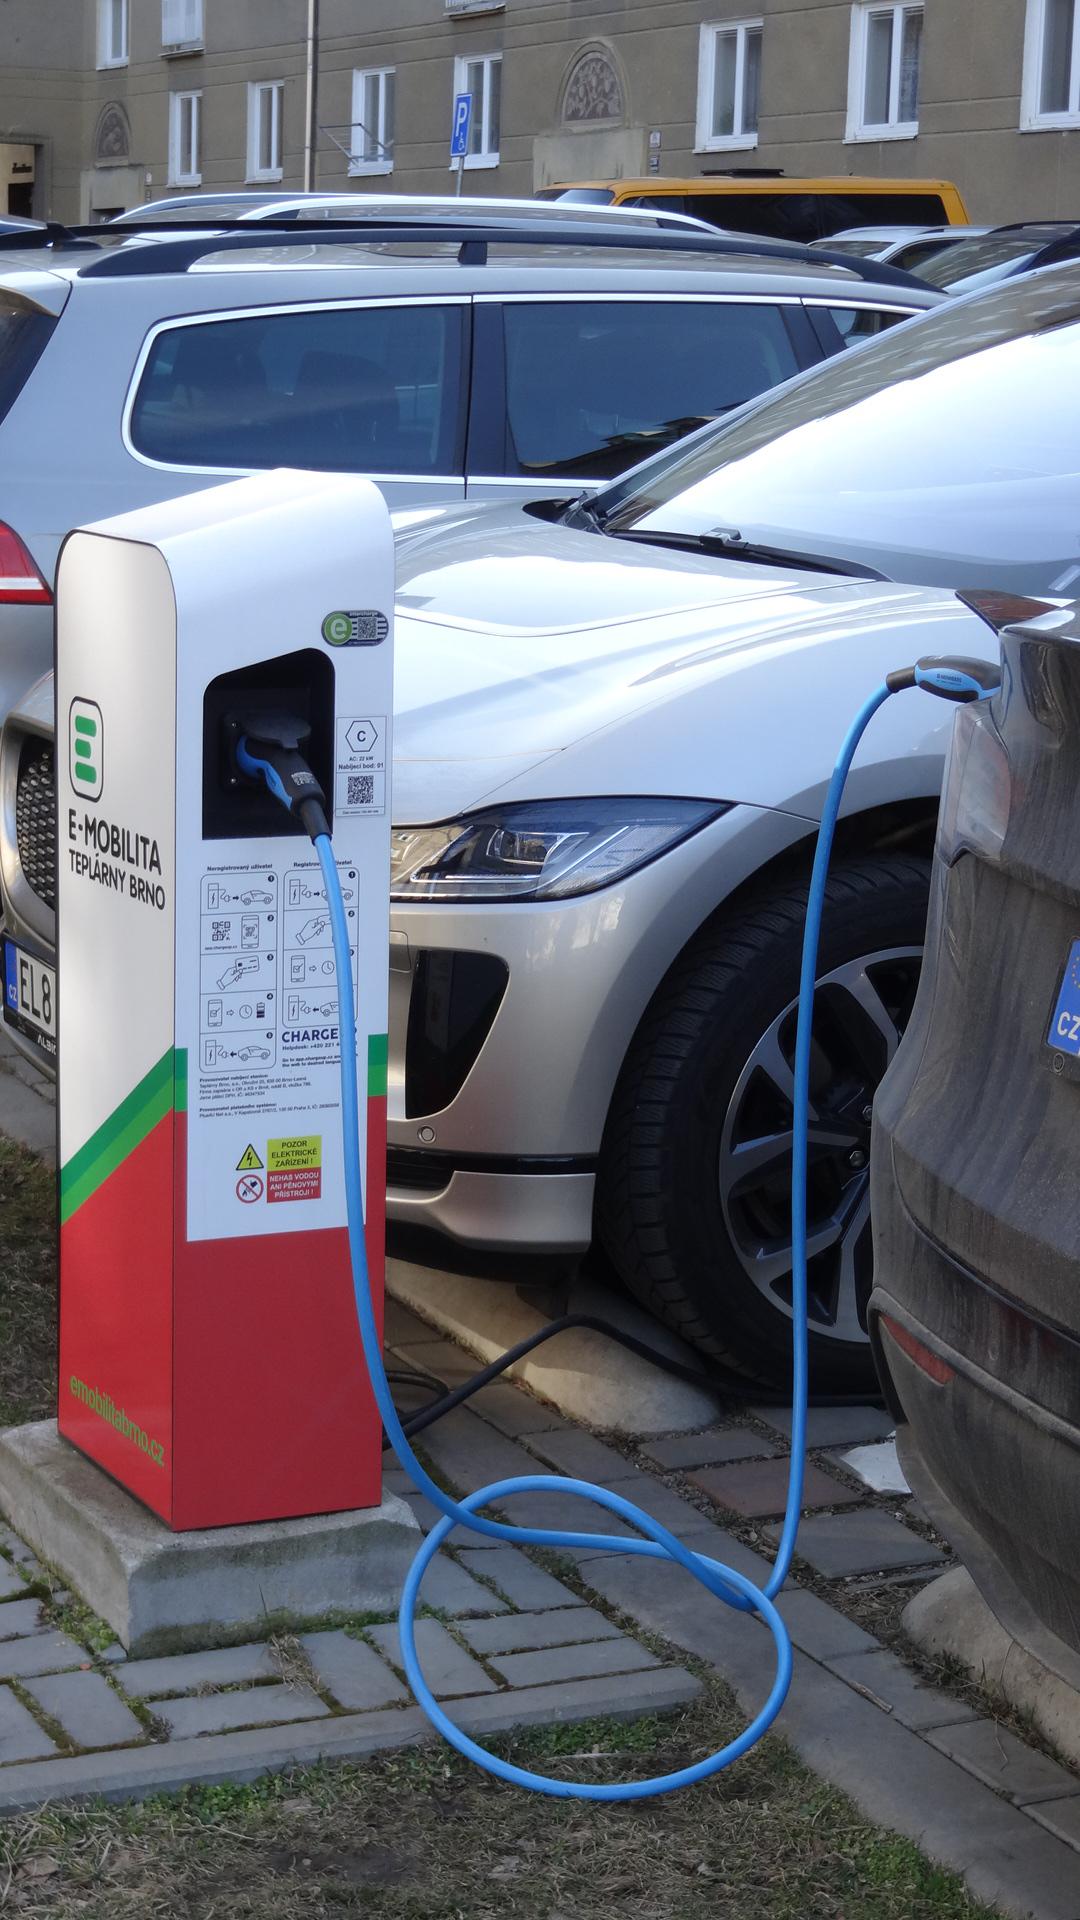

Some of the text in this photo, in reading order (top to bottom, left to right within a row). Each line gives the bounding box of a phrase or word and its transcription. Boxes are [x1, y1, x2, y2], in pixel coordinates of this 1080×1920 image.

[455, 102, 468, 137] P
[331, 618, 347, 640] e
[356, 730, 366, 742] C
[69, 849, 165, 911] TEPLÁRNY BRNO
[9, 983, 17, 1002] CZ
[19, 957, 52, 1025] EL8
[1057, 1010, 1080, 1041] CZ
[282, 1028, 340, 1043] CHARGE
[271, 1147, 318, 1159] ELEKTRICKÉ
[281, 1140, 307, 1149] POZOR
[294, 1171, 319, 1180] VODOU
[269, 1183, 282, 1191] ANI
[70, 1375, 165, 1467] emobilitabrno.cz
